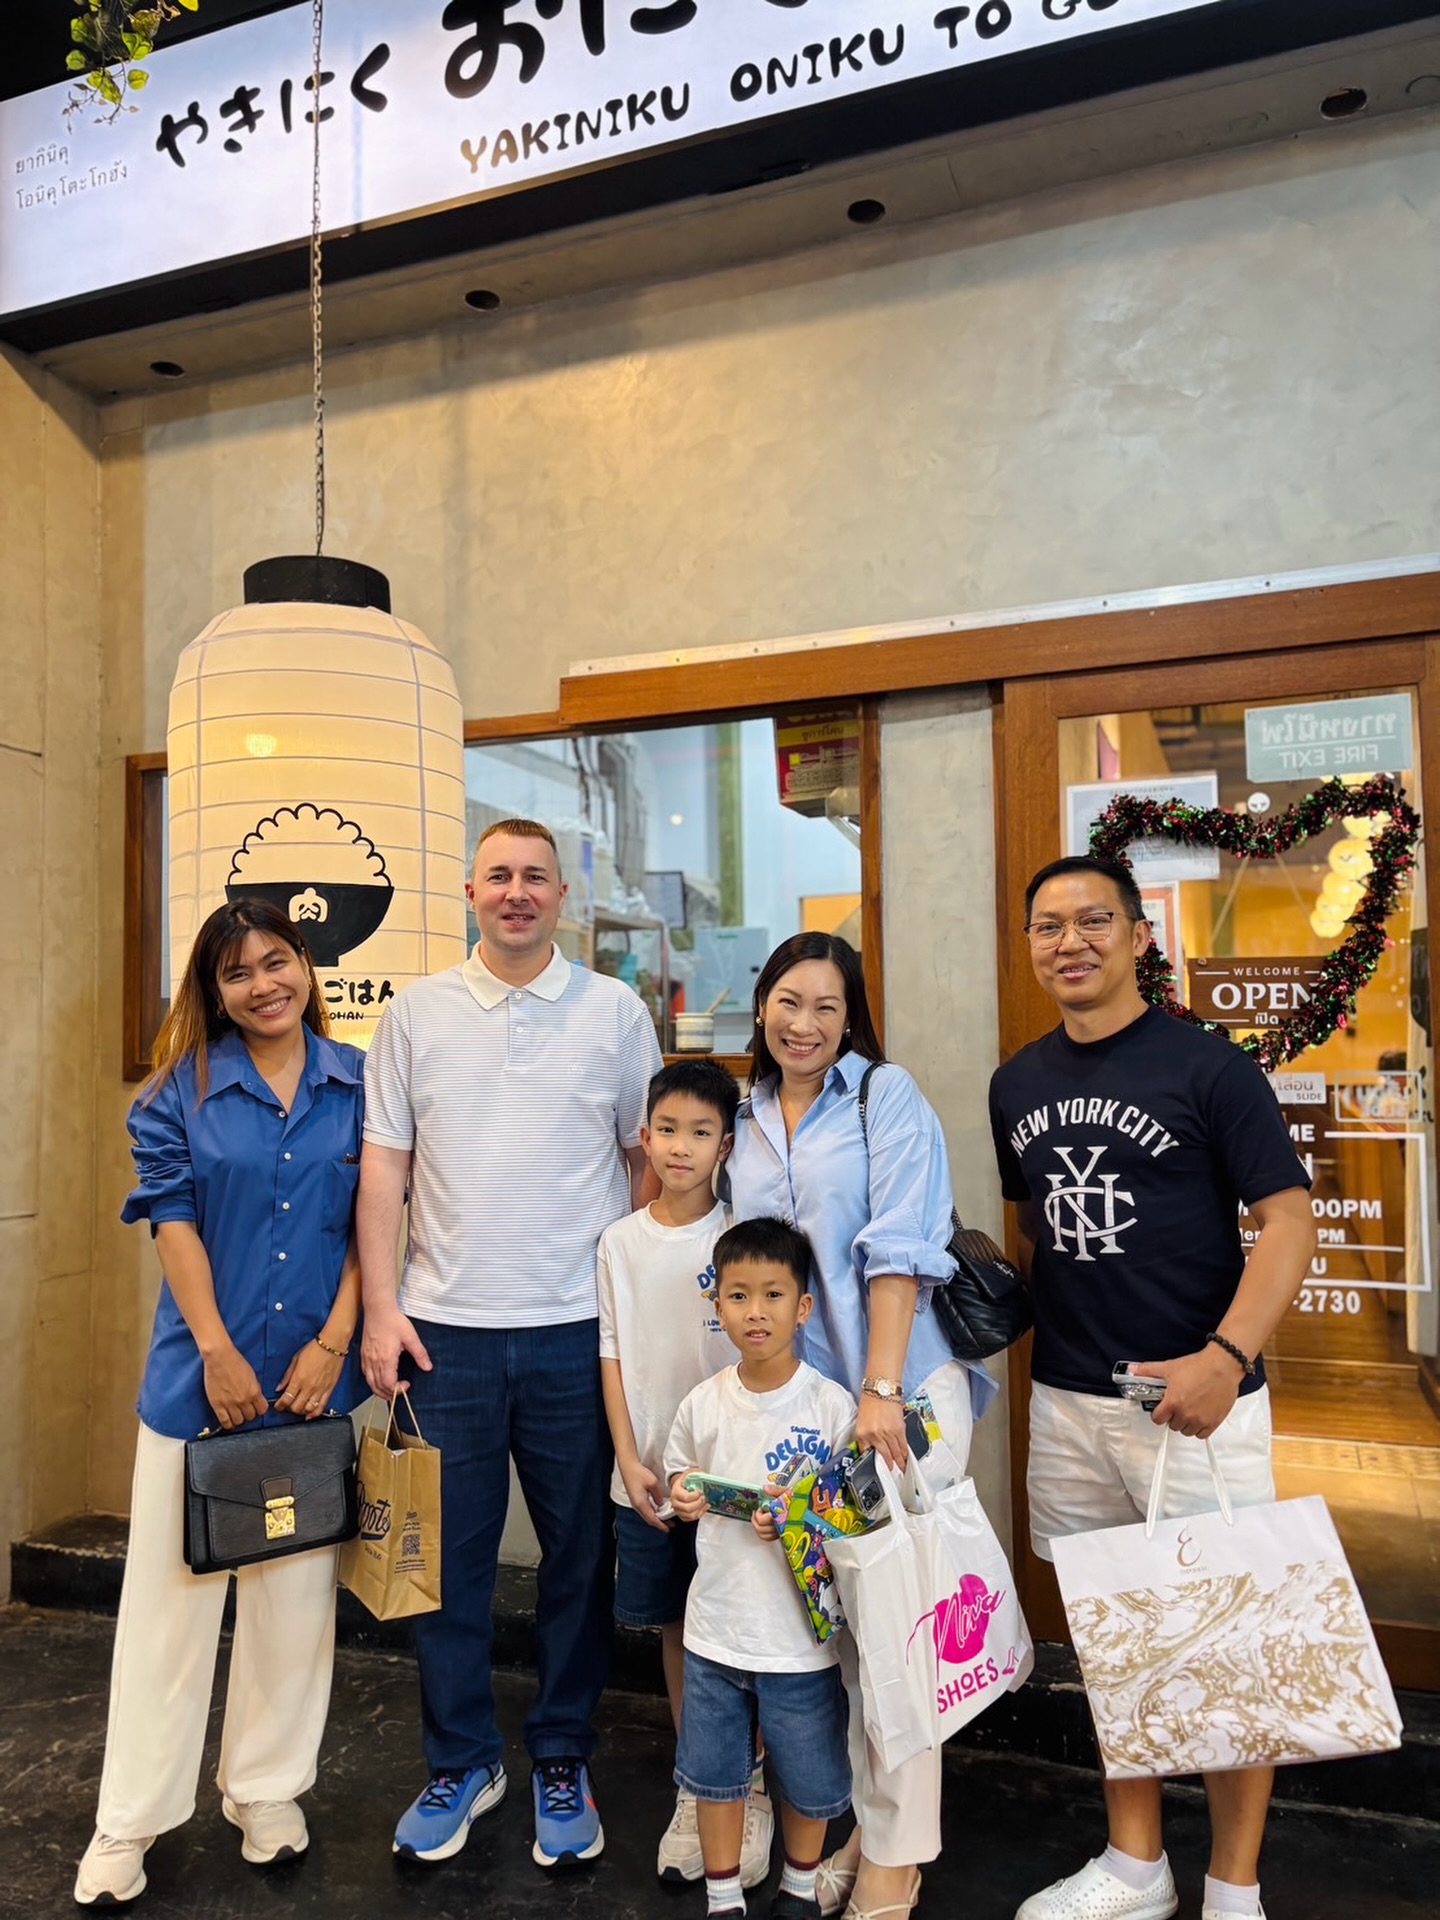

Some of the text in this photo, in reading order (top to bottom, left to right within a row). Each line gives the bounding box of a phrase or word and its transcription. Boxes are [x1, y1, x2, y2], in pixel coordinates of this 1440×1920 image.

[460, 83, 690, 174] YAKINIKU
[729, 23, 905, 102] ONIKU
[933, 0, 1012, 49] TO
[156, 43, 391, 168] やきにく
[16, 144, 69, 174] ยากินิคุ
[1233, 966, 1300, 976] WELCOME
[324, 978, 394, 1005] ごはん
[1212, 982, 1320, 1010] OPEN
[1254, 1011, 1279, 1025] เปิด
[1296, 1092, 1323, 1101] SLIDE
[1010, 1097, 1180, 1158] NEW YORK CITY
[764, 1434, 832, 1471] DELIGH
[937, 1656, 999, 1714] SHOES
